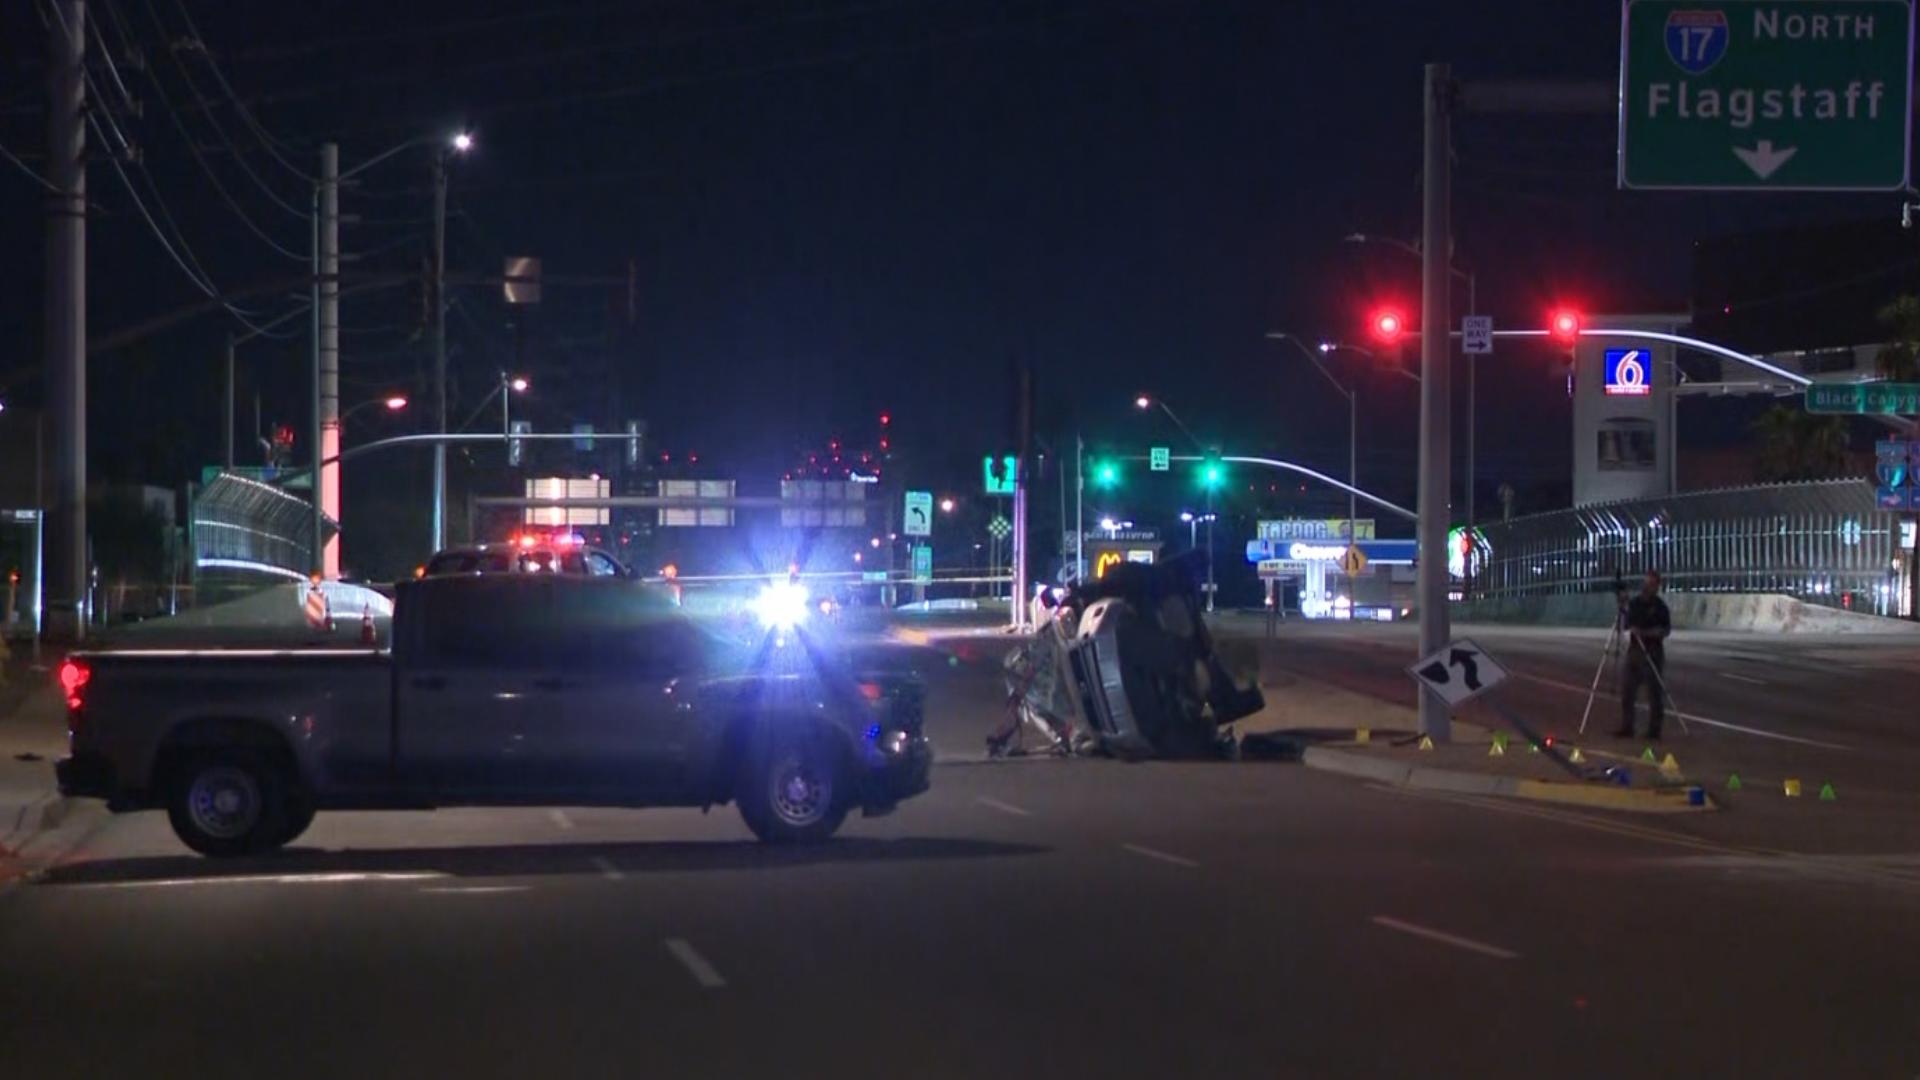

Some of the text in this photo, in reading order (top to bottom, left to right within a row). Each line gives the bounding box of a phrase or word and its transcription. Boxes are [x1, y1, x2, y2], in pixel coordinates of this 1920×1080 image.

[1753, 8, 1875, 40] NORTH
[1679, 27, 1714, 61] 17
[1647, 81, 1885, 129] Flagstaff
[1467, 319, 1487, 329] ONE
[1467, 329, 1487, 337] WAY
[1615, 350, 1644, 386] 6
[1815, 389, 1857, 406] Black
